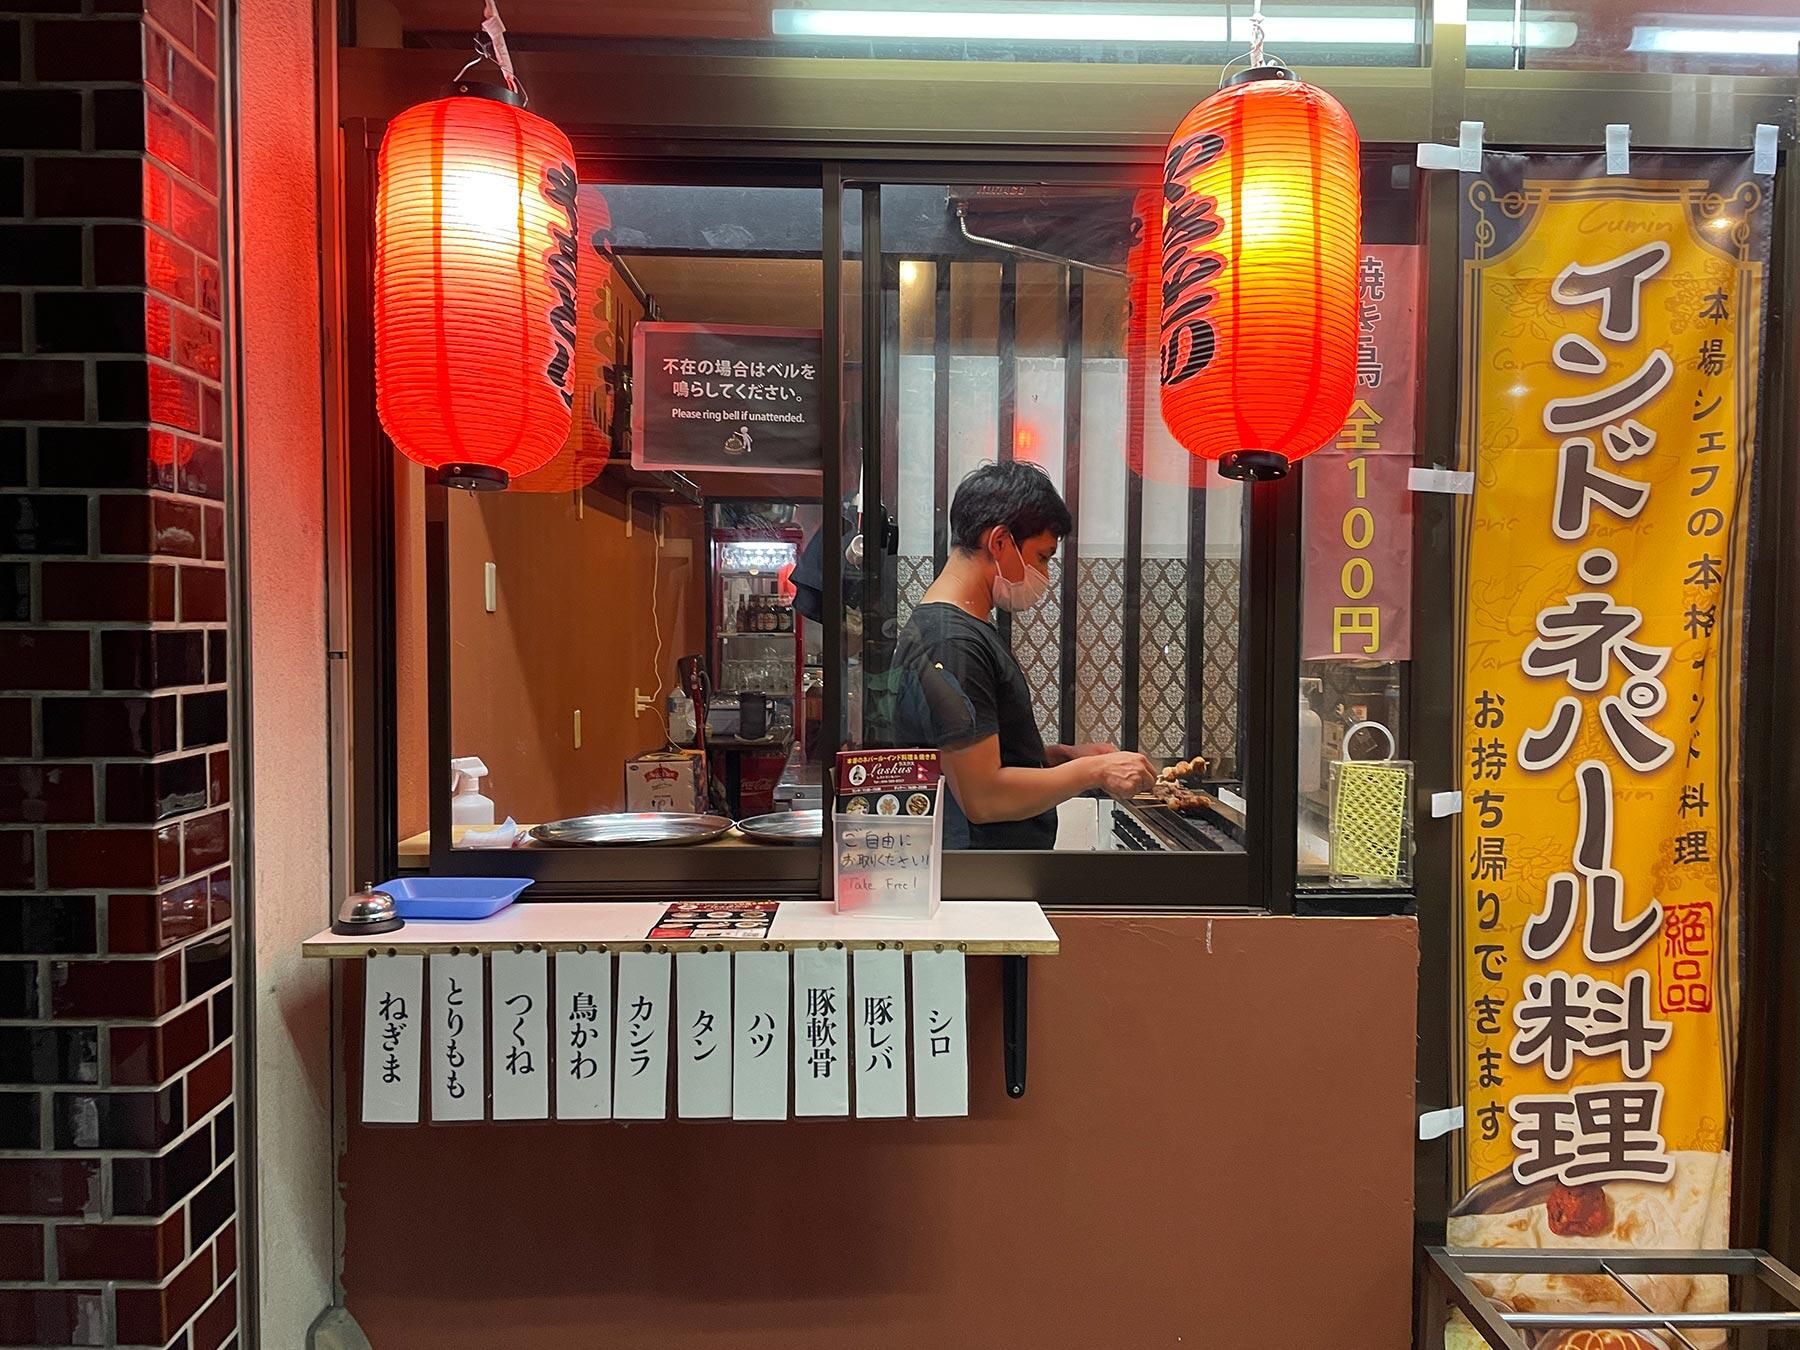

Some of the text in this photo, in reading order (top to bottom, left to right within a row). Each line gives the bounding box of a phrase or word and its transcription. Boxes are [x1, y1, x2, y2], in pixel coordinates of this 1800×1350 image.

[662, 358, 816, 380] 不在の場合はベルを
[672, 380, 803, 402] 鳴らしてください。
[672, 408, 805, 423] Please ring bell if unattended.
[1509, 241, 1675, 1186] インド・ネパール料理
[845, 828, 912, 849] ご自由に
[846, 876, 876, 891] Take
[1470, 690, 1508, 1141] お持ち帰りできます
[1663, 906, 1709, 1010] 絶品
[379, 991, 408, 1084] ねぎま
[446, 977, 465, 1098] とりもも
[505, 994, 535, 1076] つくね
[569, 991, 598, 1080] 鳥かわ
[628, 995, 654, 1077] カシラ
[692, 1009, 718, 1061] タン
[747, 1012, 775, 1058] ハツ
[806, 986, 837, 1079] 豚軟骨
[864, 995, 894, 1072] 豚レバ
[929, 1010, 953, 1057] シロ
